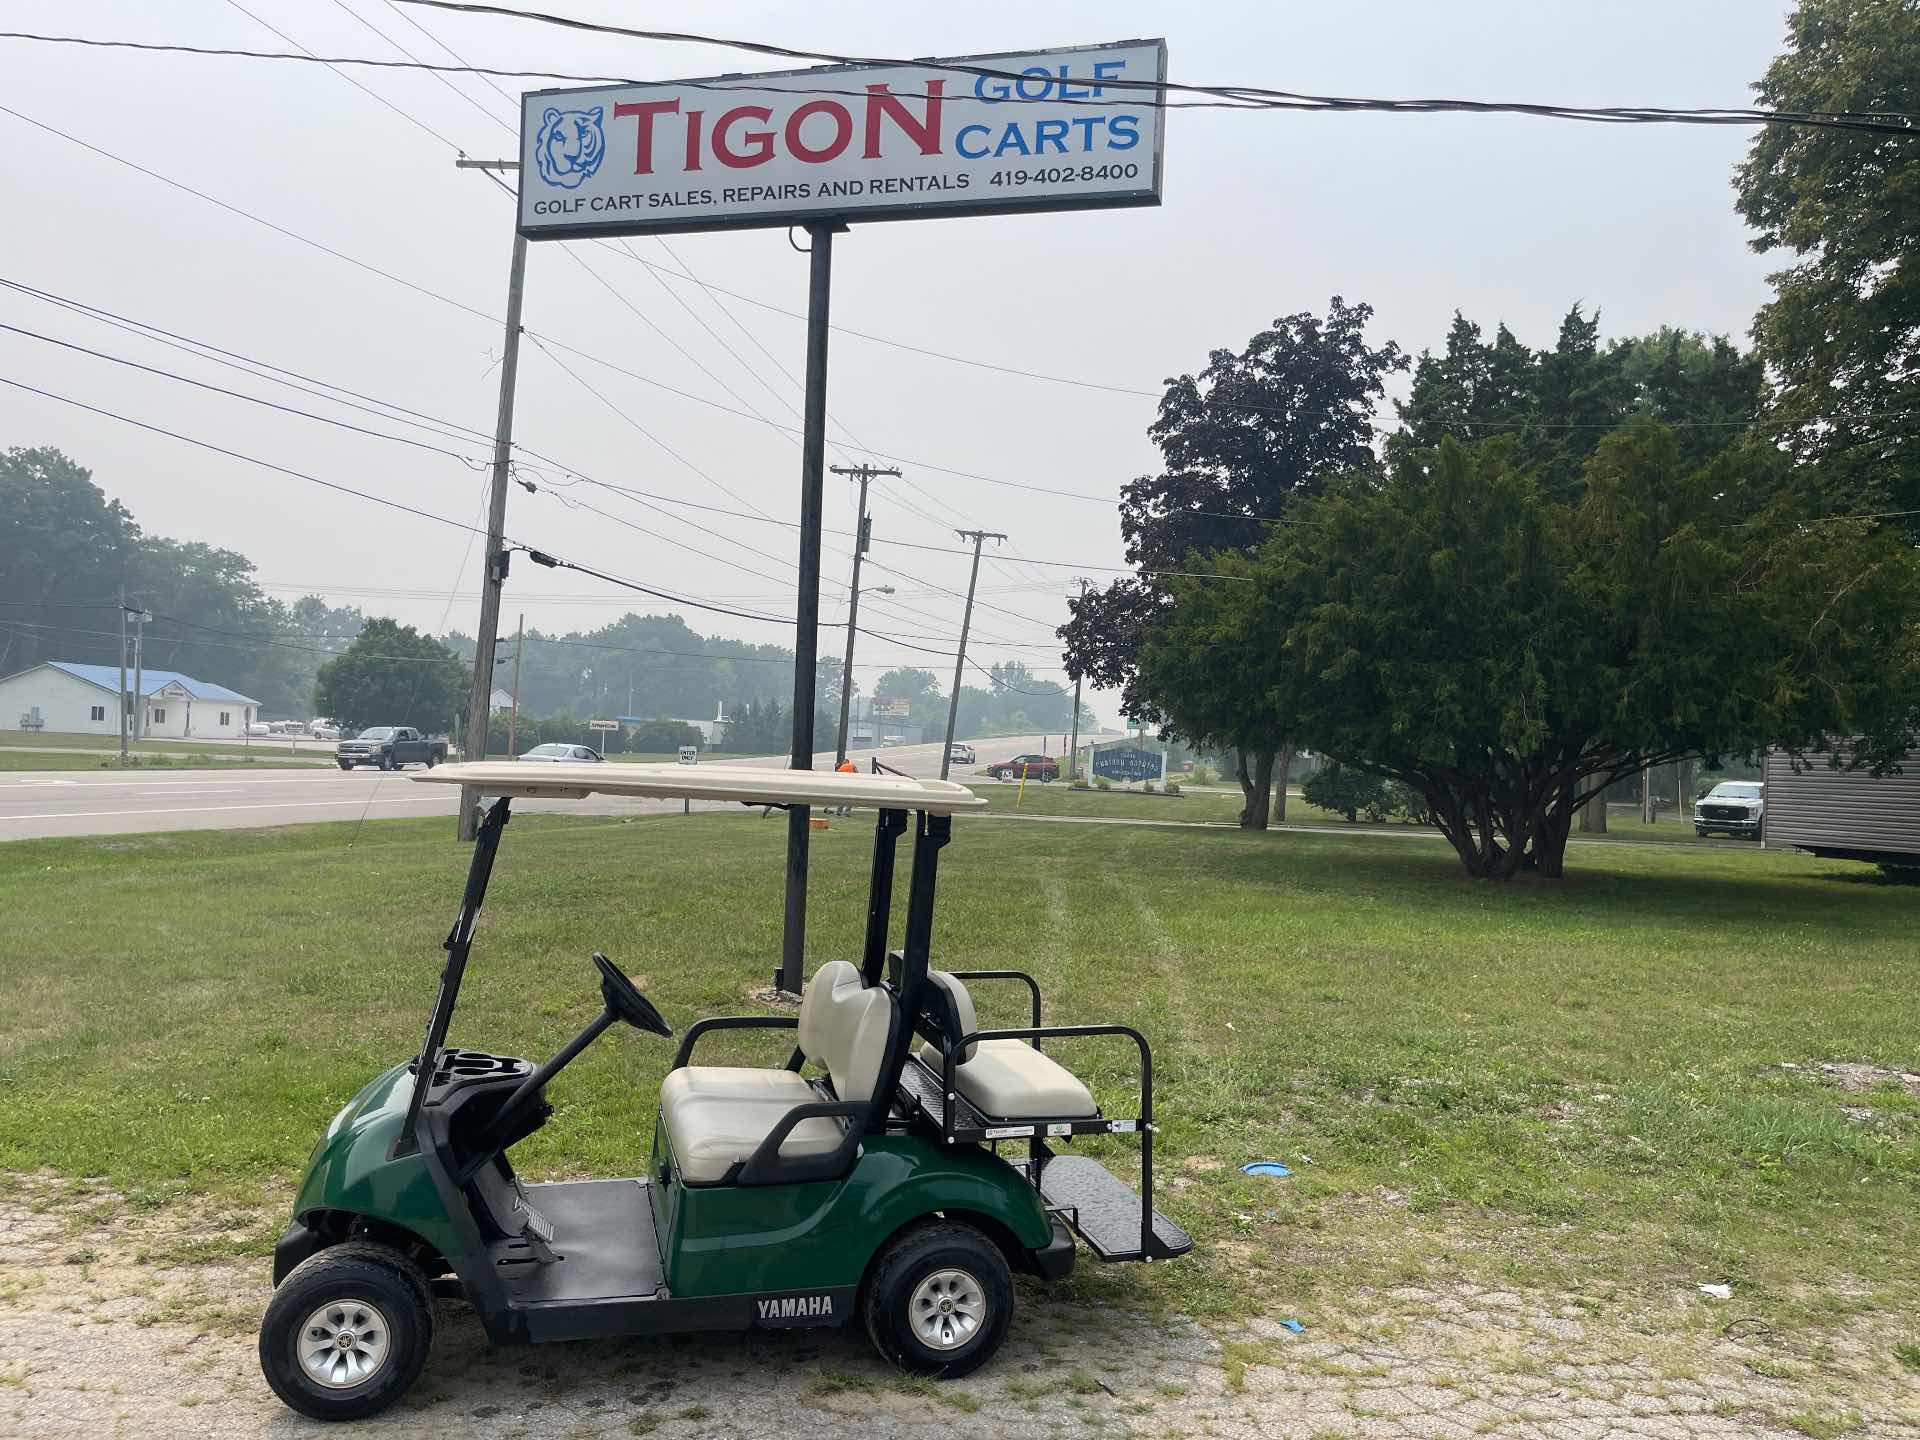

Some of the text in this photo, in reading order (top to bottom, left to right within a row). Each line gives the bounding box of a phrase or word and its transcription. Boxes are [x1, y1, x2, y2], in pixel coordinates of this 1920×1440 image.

[974, 59, 1126, 105] GOLF
[613, 79, 946, 175] TIGON
[955, 115, 1141, 160] CARTS
[534, 173, 970, 215] GOLF CART SALES, REPAIRS AND RENTALS
[989, 162, 1138, 186] 419-402-8400
[757, 1295, 833, 1318] YAMAHA
